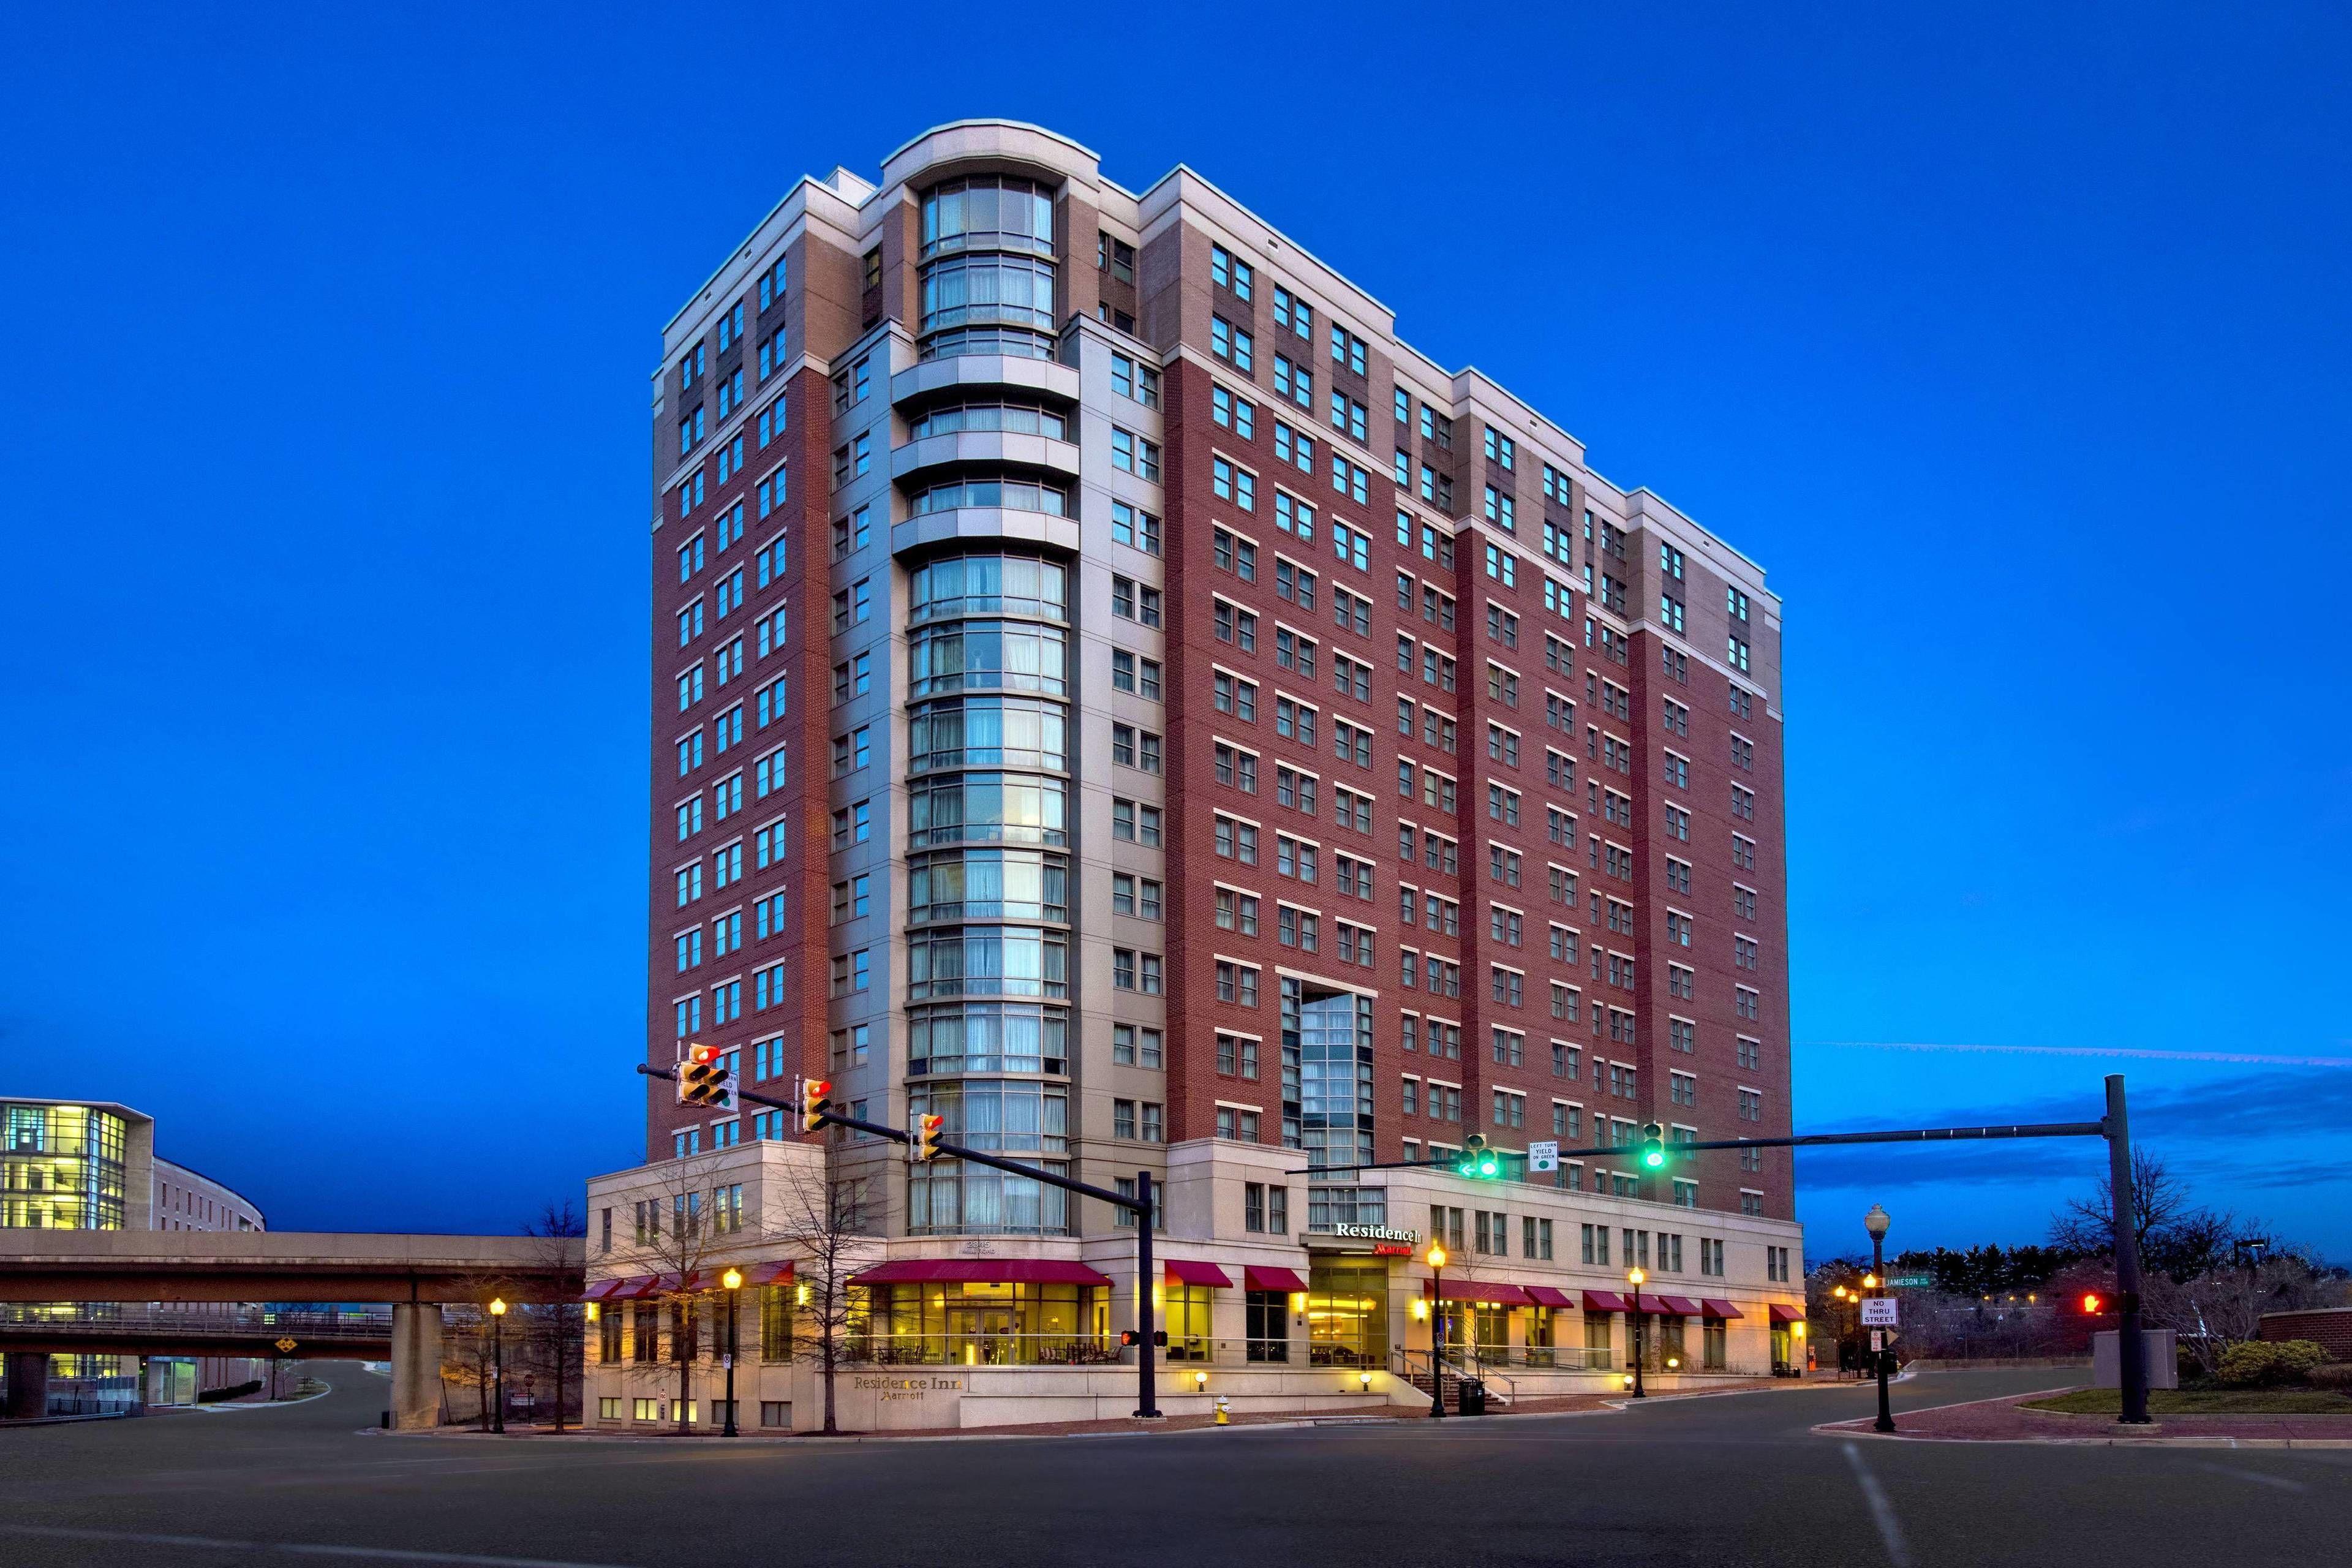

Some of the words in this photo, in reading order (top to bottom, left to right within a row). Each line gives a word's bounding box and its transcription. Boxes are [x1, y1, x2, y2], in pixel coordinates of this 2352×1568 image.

[1336, 1223, 1413, 1242] Residence
[854, 1376, 927, 1390] Residence
[930, 1377, 962, 1390] Inn
[880, 1392, 924, 1401] Marriott
